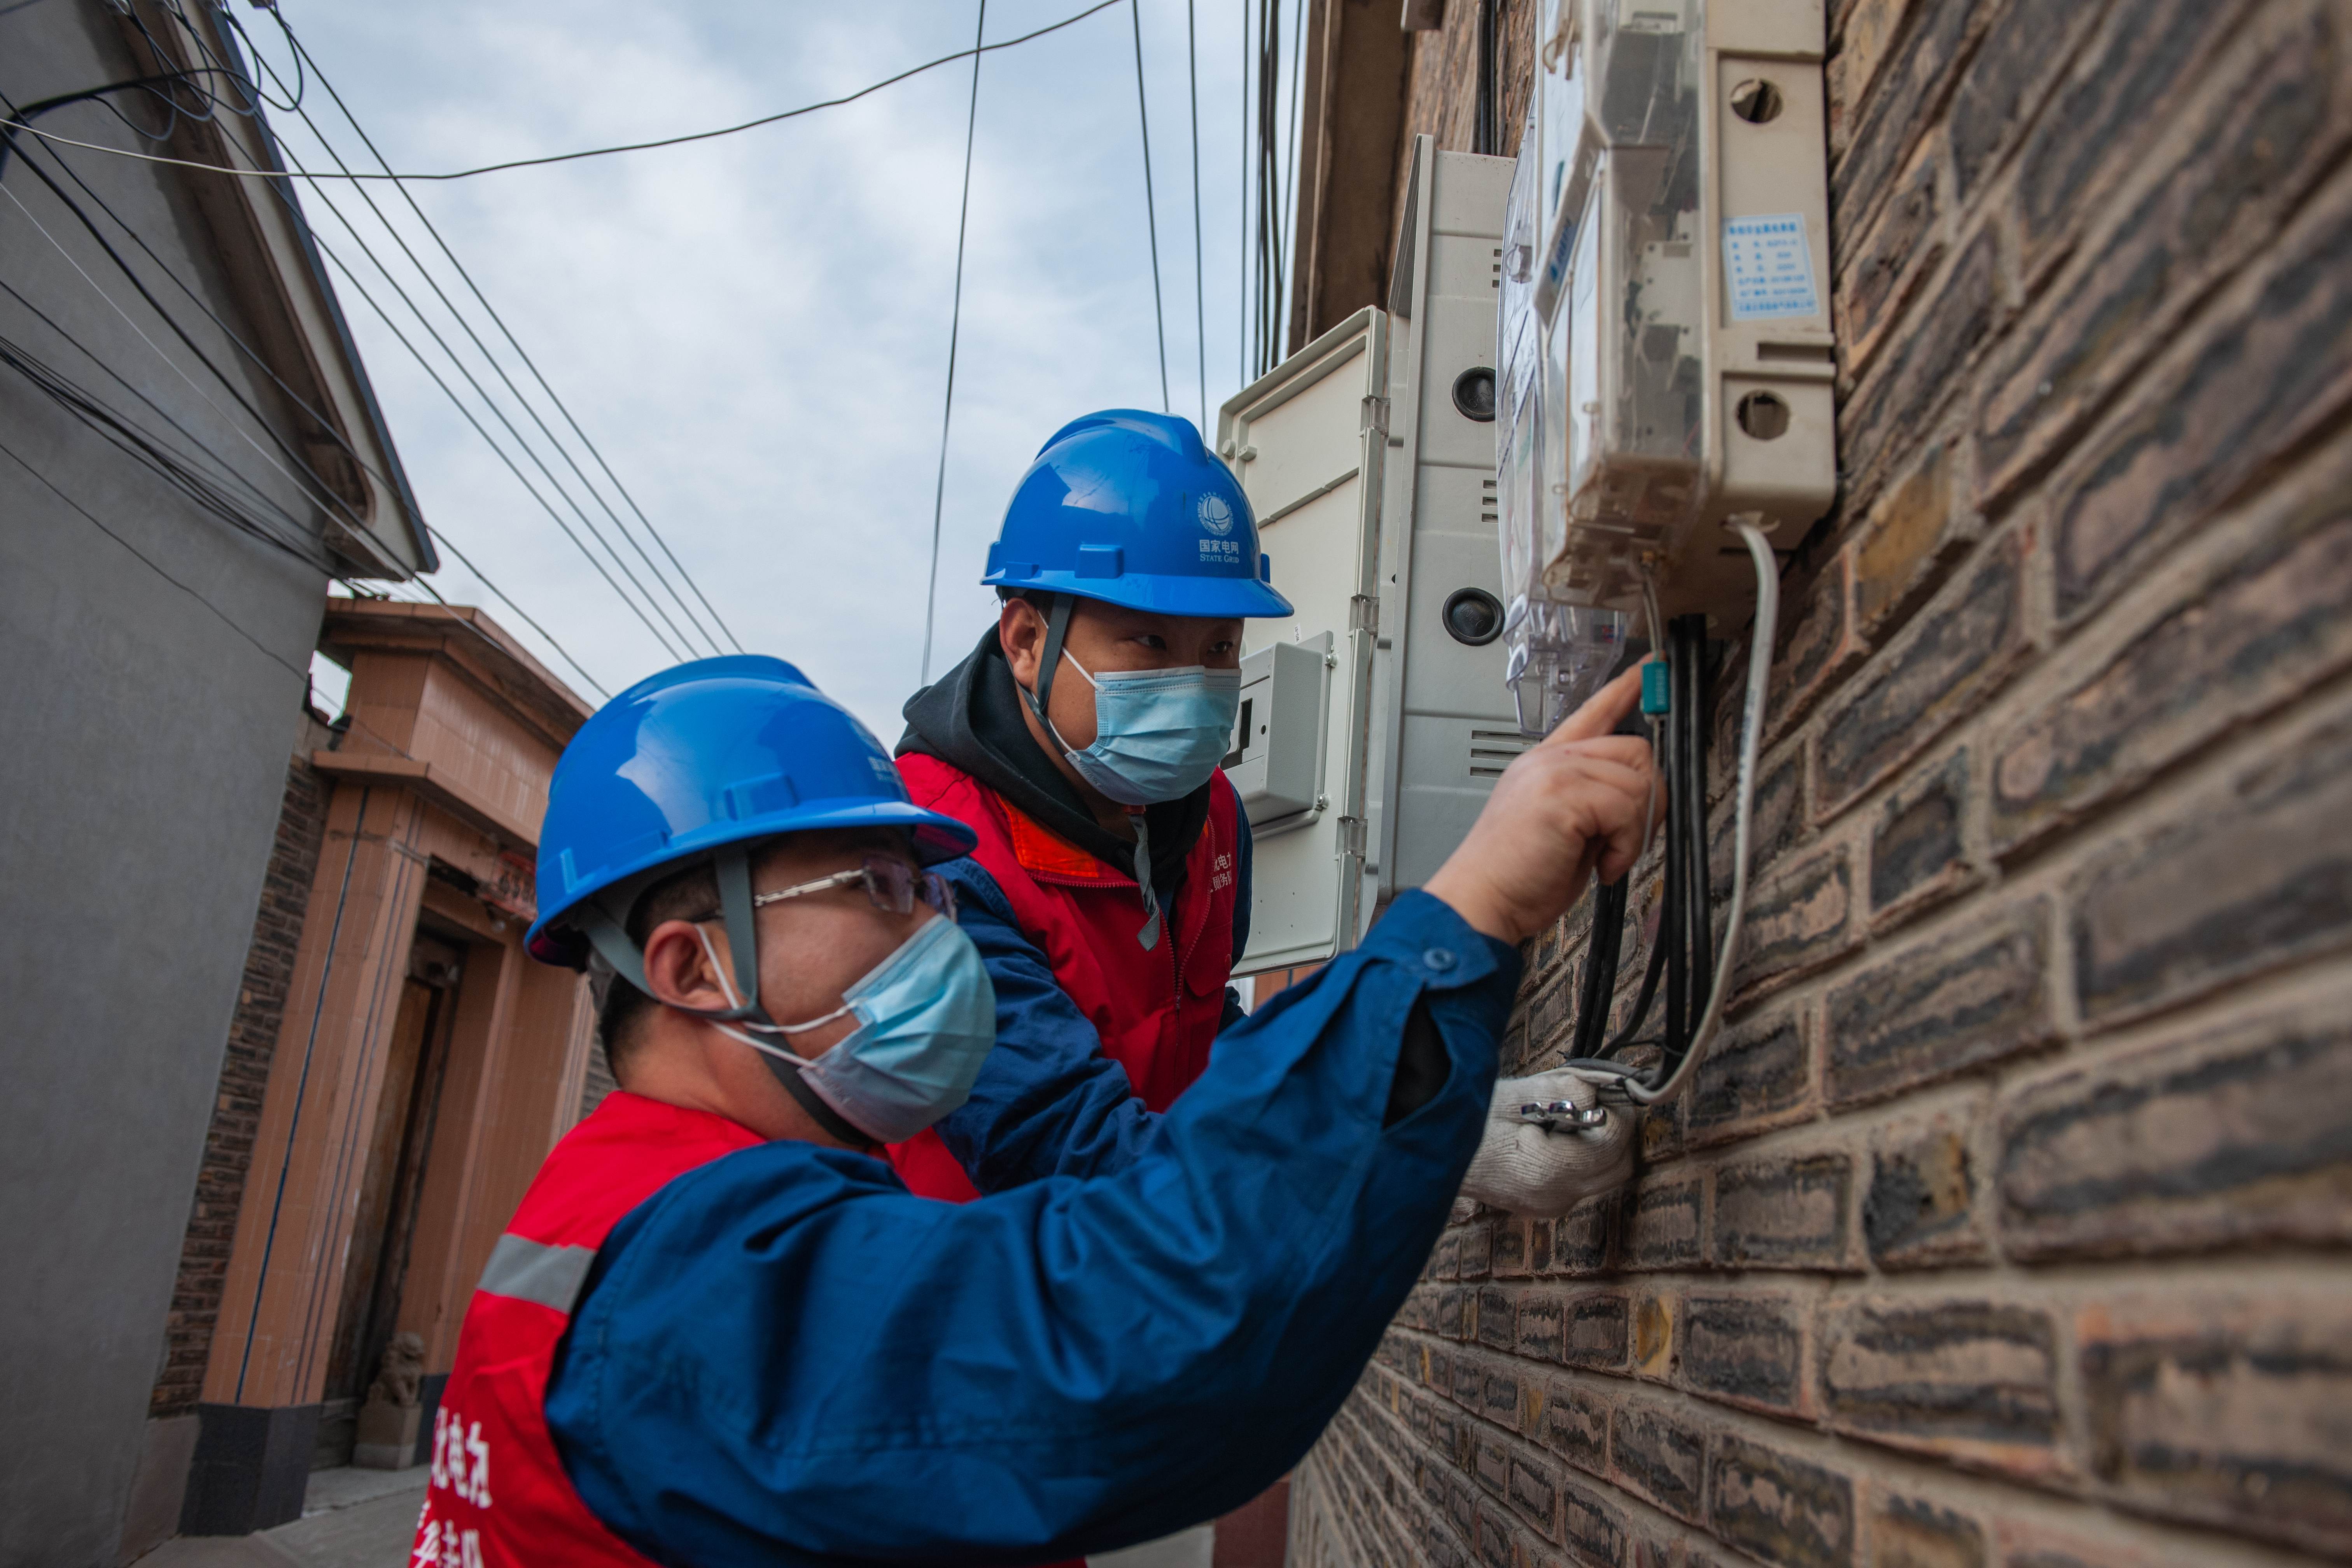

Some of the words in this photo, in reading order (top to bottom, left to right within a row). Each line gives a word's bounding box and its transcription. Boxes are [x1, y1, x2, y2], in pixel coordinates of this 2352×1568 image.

[1199, 539, 1239, 554] 国家电网
[1200, 554, 1222, 562] STATE
[1224, 555, 1239, 564] GRID
